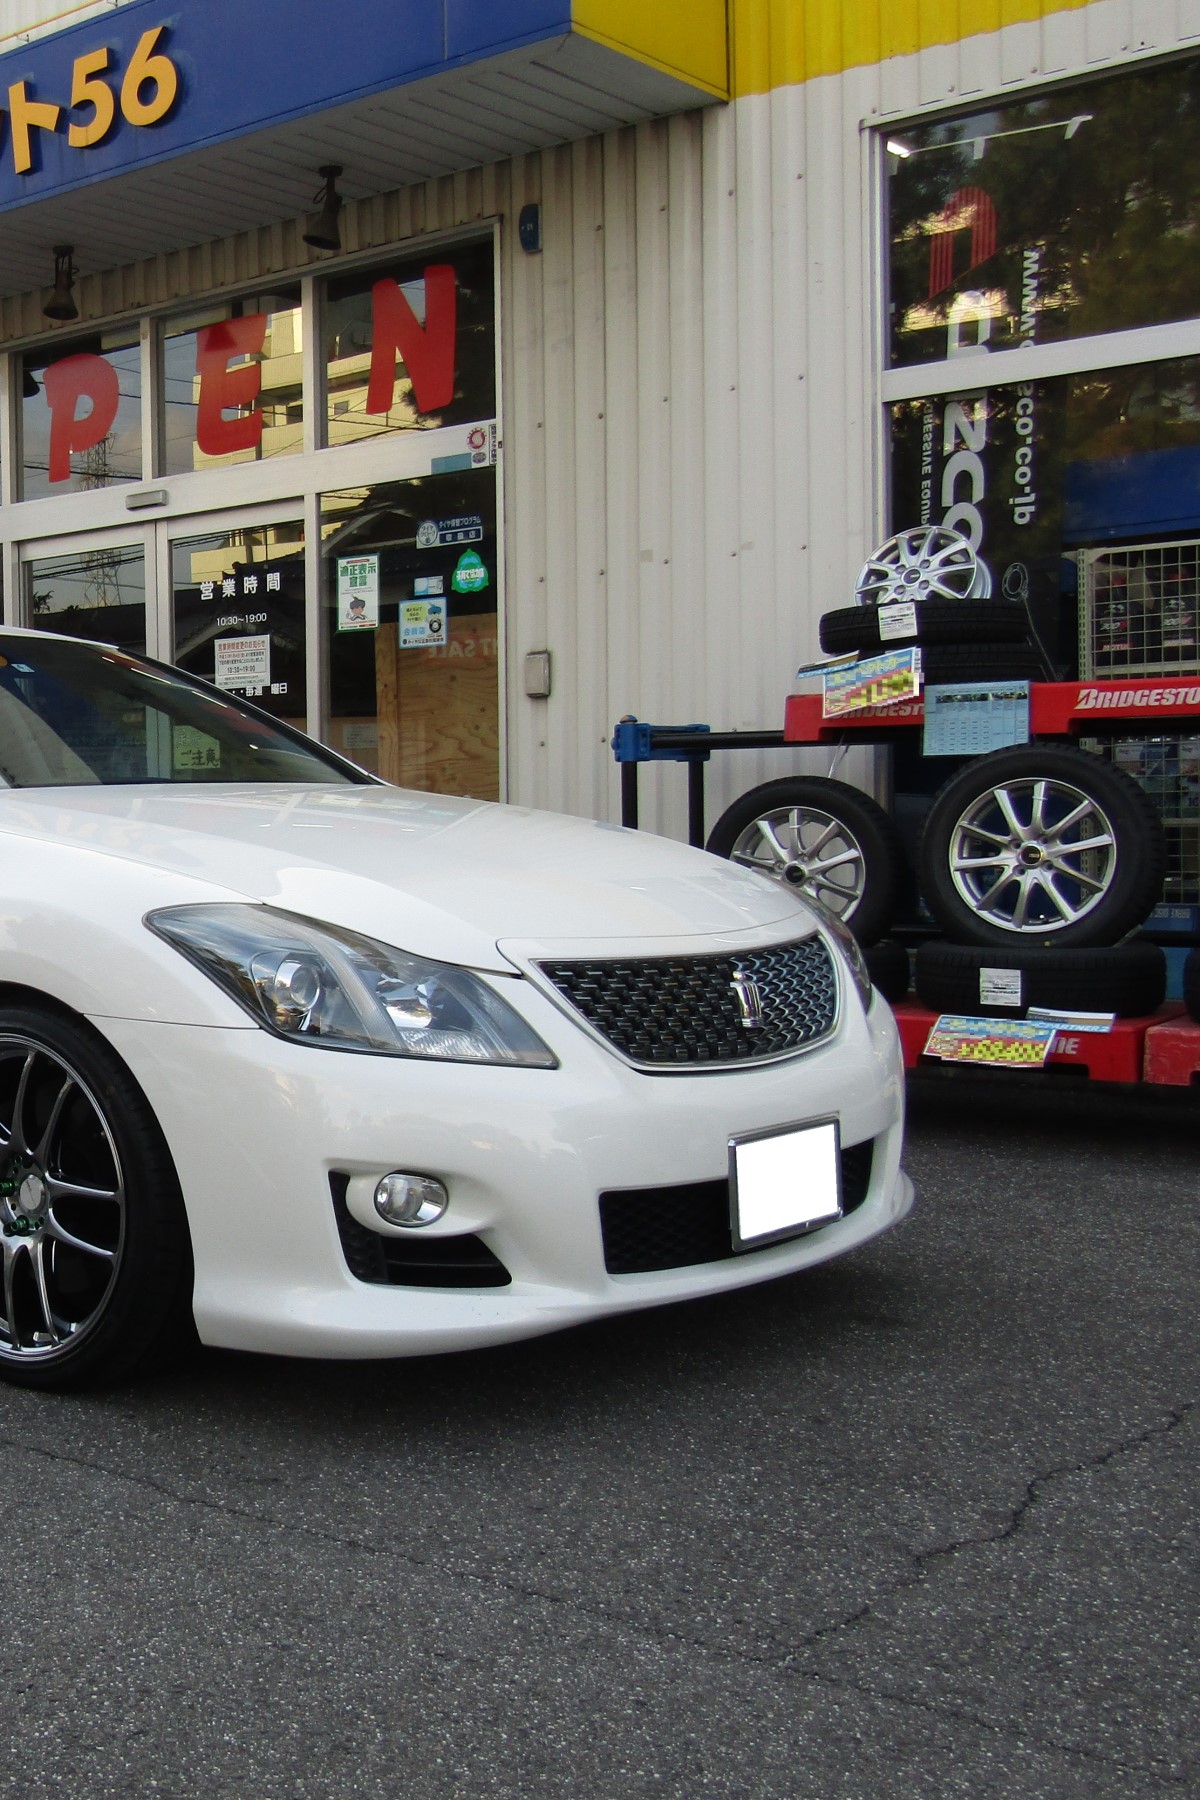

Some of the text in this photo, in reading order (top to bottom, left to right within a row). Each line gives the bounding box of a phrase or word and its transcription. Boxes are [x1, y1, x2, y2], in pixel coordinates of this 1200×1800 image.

[340, 562, 377, 577] 適正表示
[200, 572, 280, 600] 営業時間
